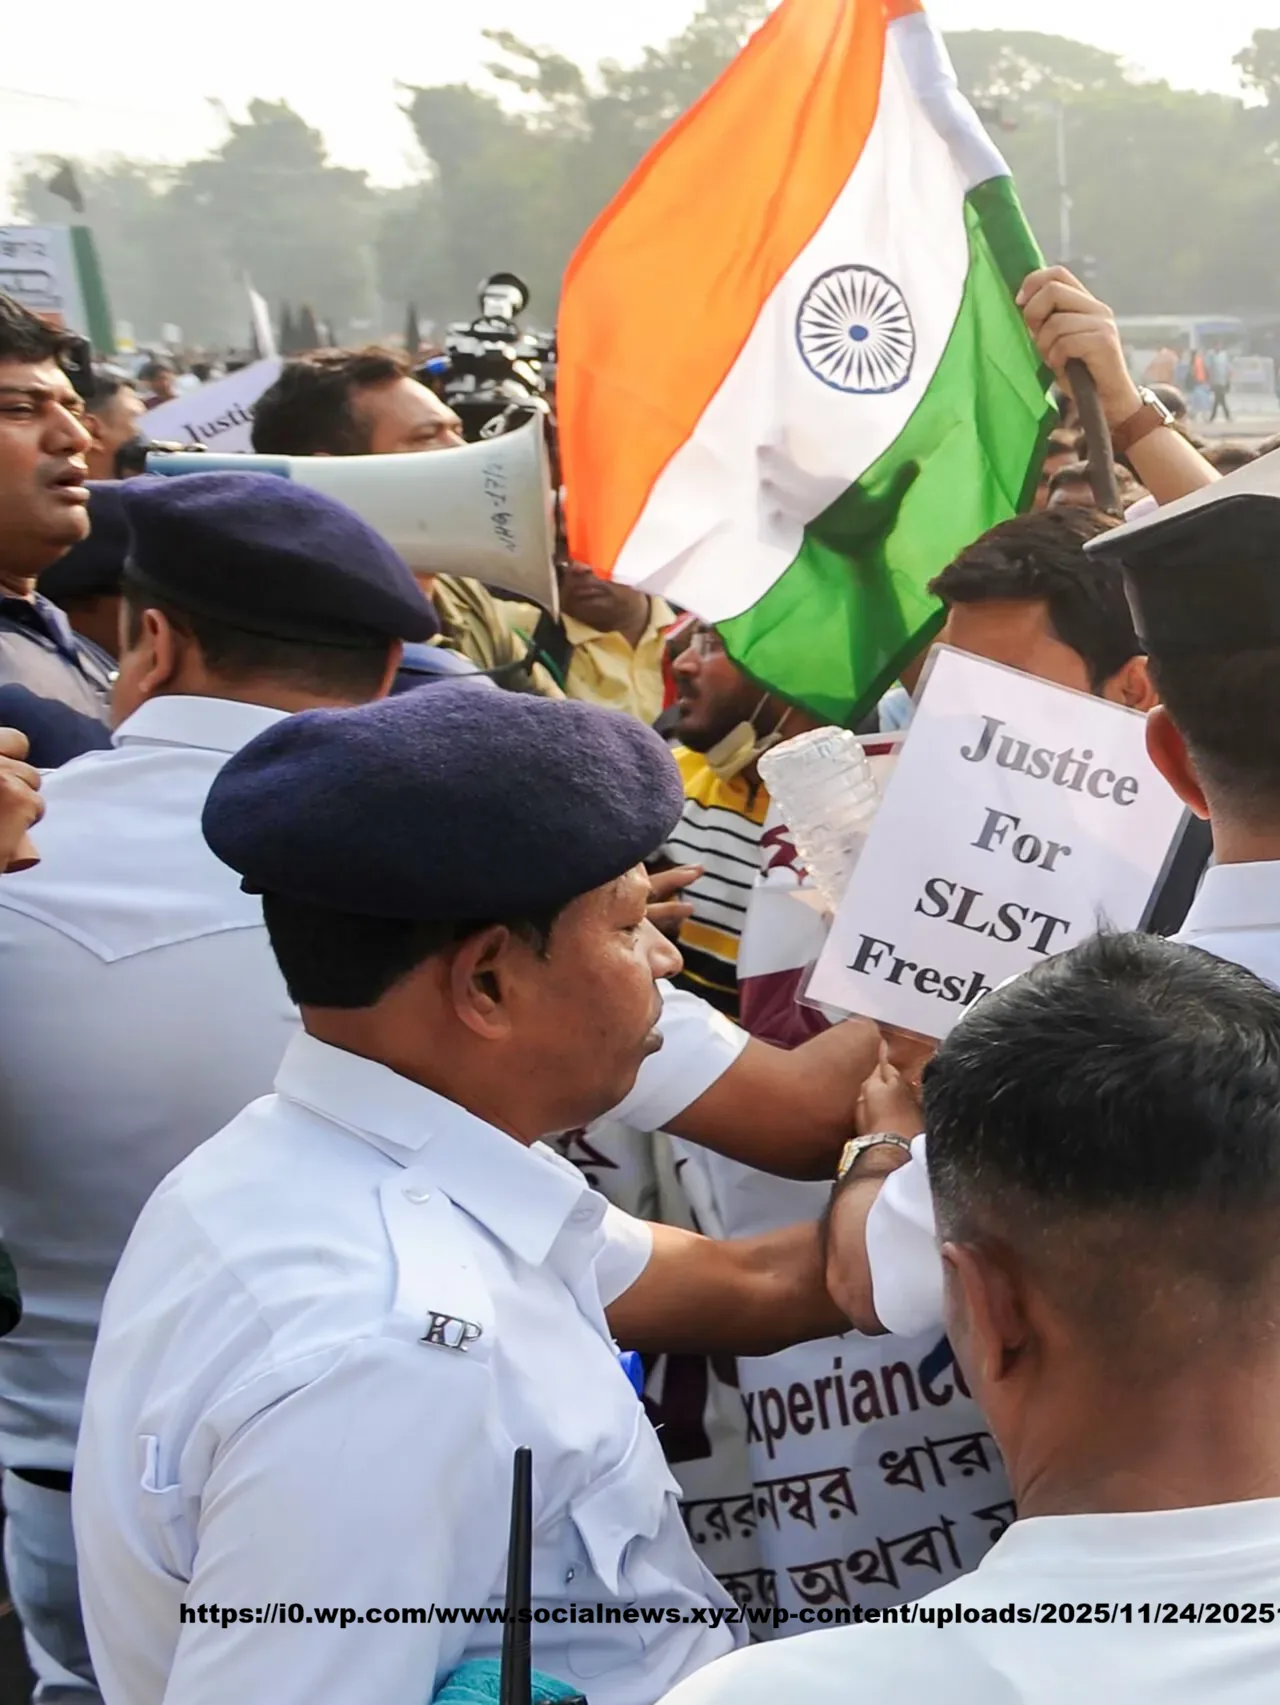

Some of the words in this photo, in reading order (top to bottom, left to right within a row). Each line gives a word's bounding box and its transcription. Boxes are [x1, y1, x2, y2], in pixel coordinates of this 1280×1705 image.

[960, 715, 1139, 806] Justice
[970, 807, 1072, 872] For
[914, 877, 1070, 956] SLST
[846, 933, 992, 1006] Fresh
[420, 1309, 482, 1353] KP
[878, 1431, 1004, 1494] ধার
[787, 1515, 964, 1606] অথবা
